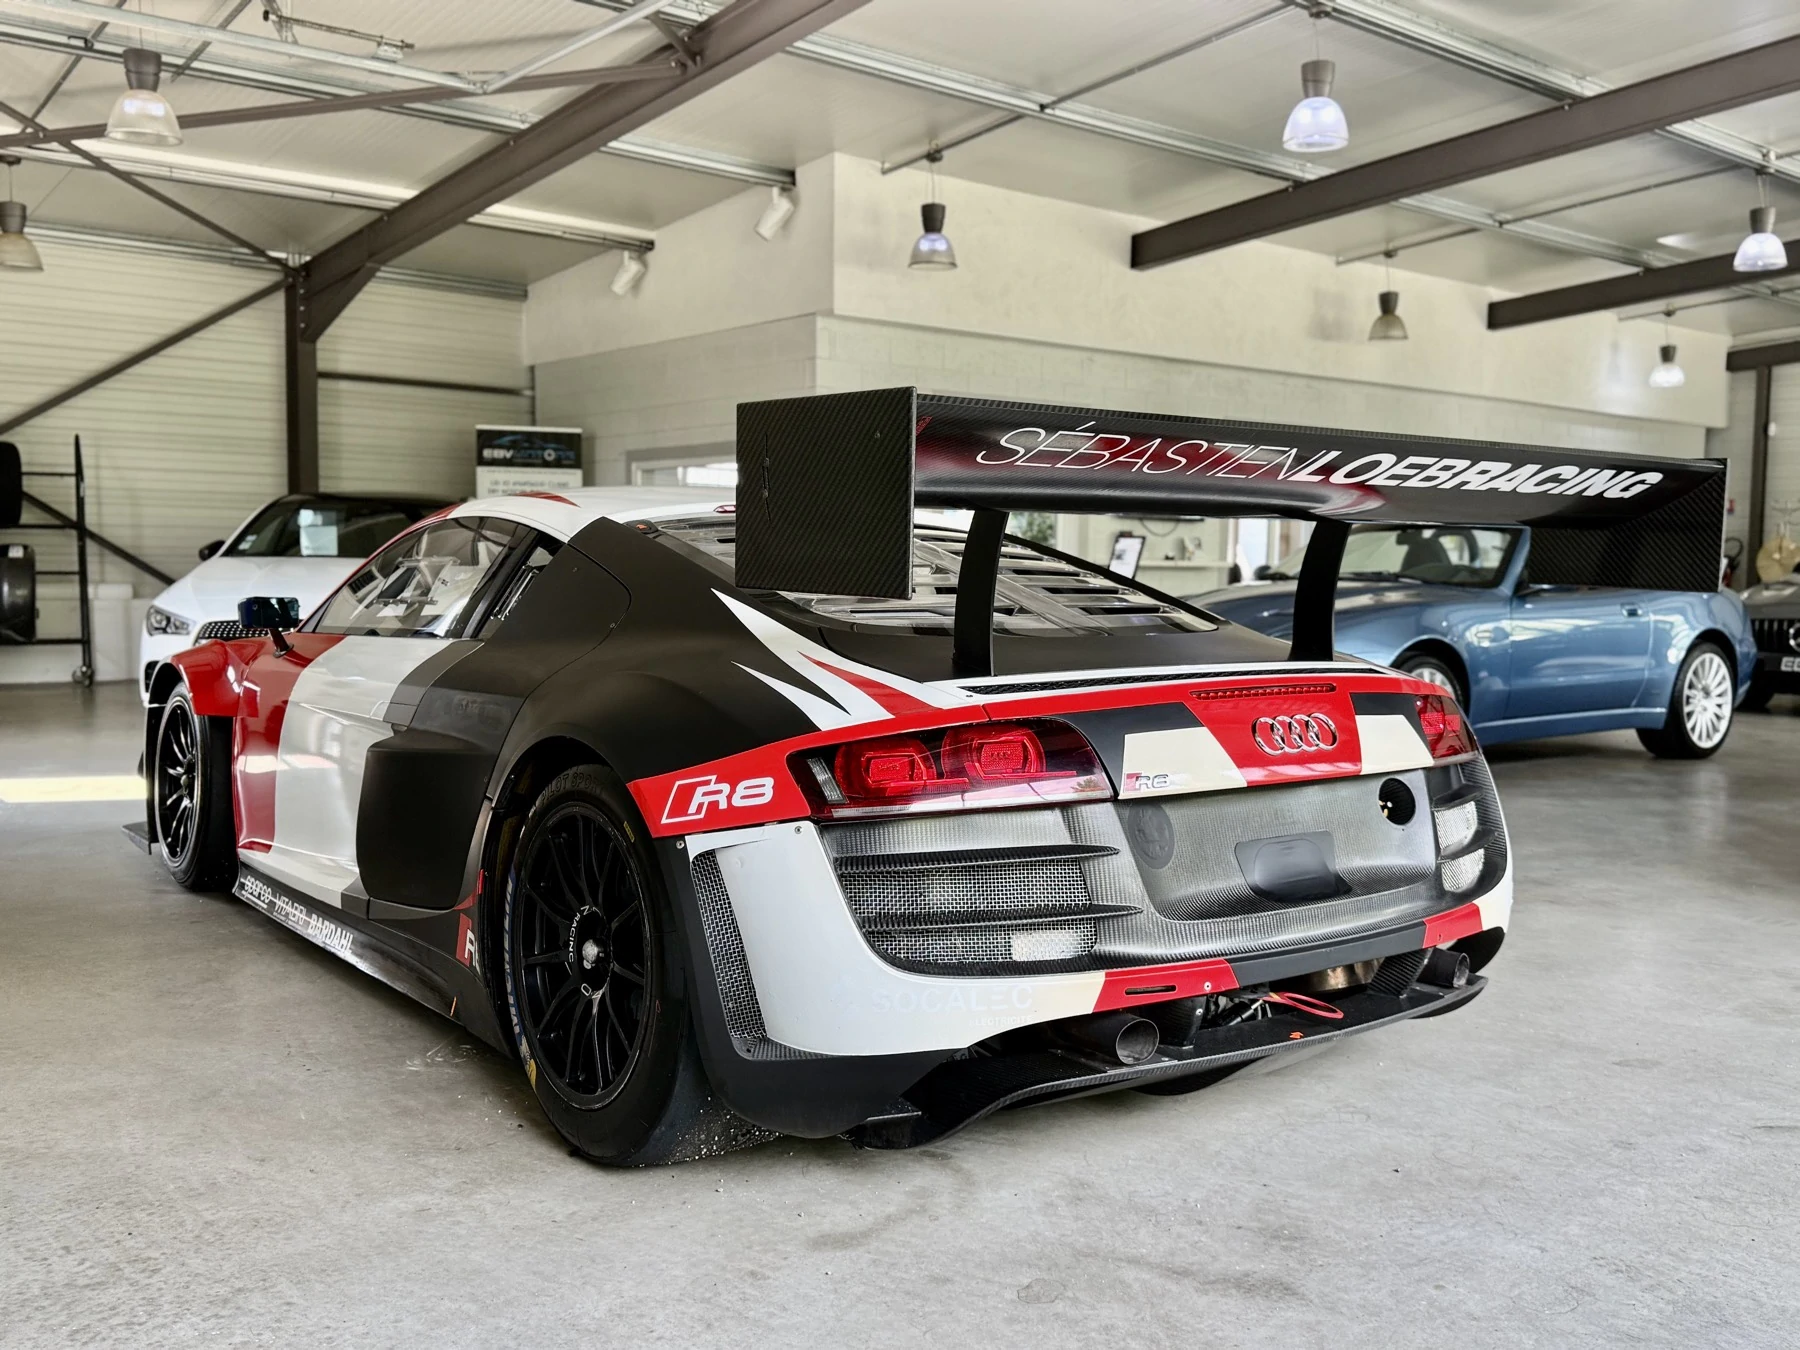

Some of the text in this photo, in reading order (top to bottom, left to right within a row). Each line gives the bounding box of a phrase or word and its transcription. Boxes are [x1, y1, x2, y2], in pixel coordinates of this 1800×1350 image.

[686, 776, 775, 815] R8
[308, 914, 354, 954] BARDAHL
[872, 985, 1032, 1012] SOCALEC
